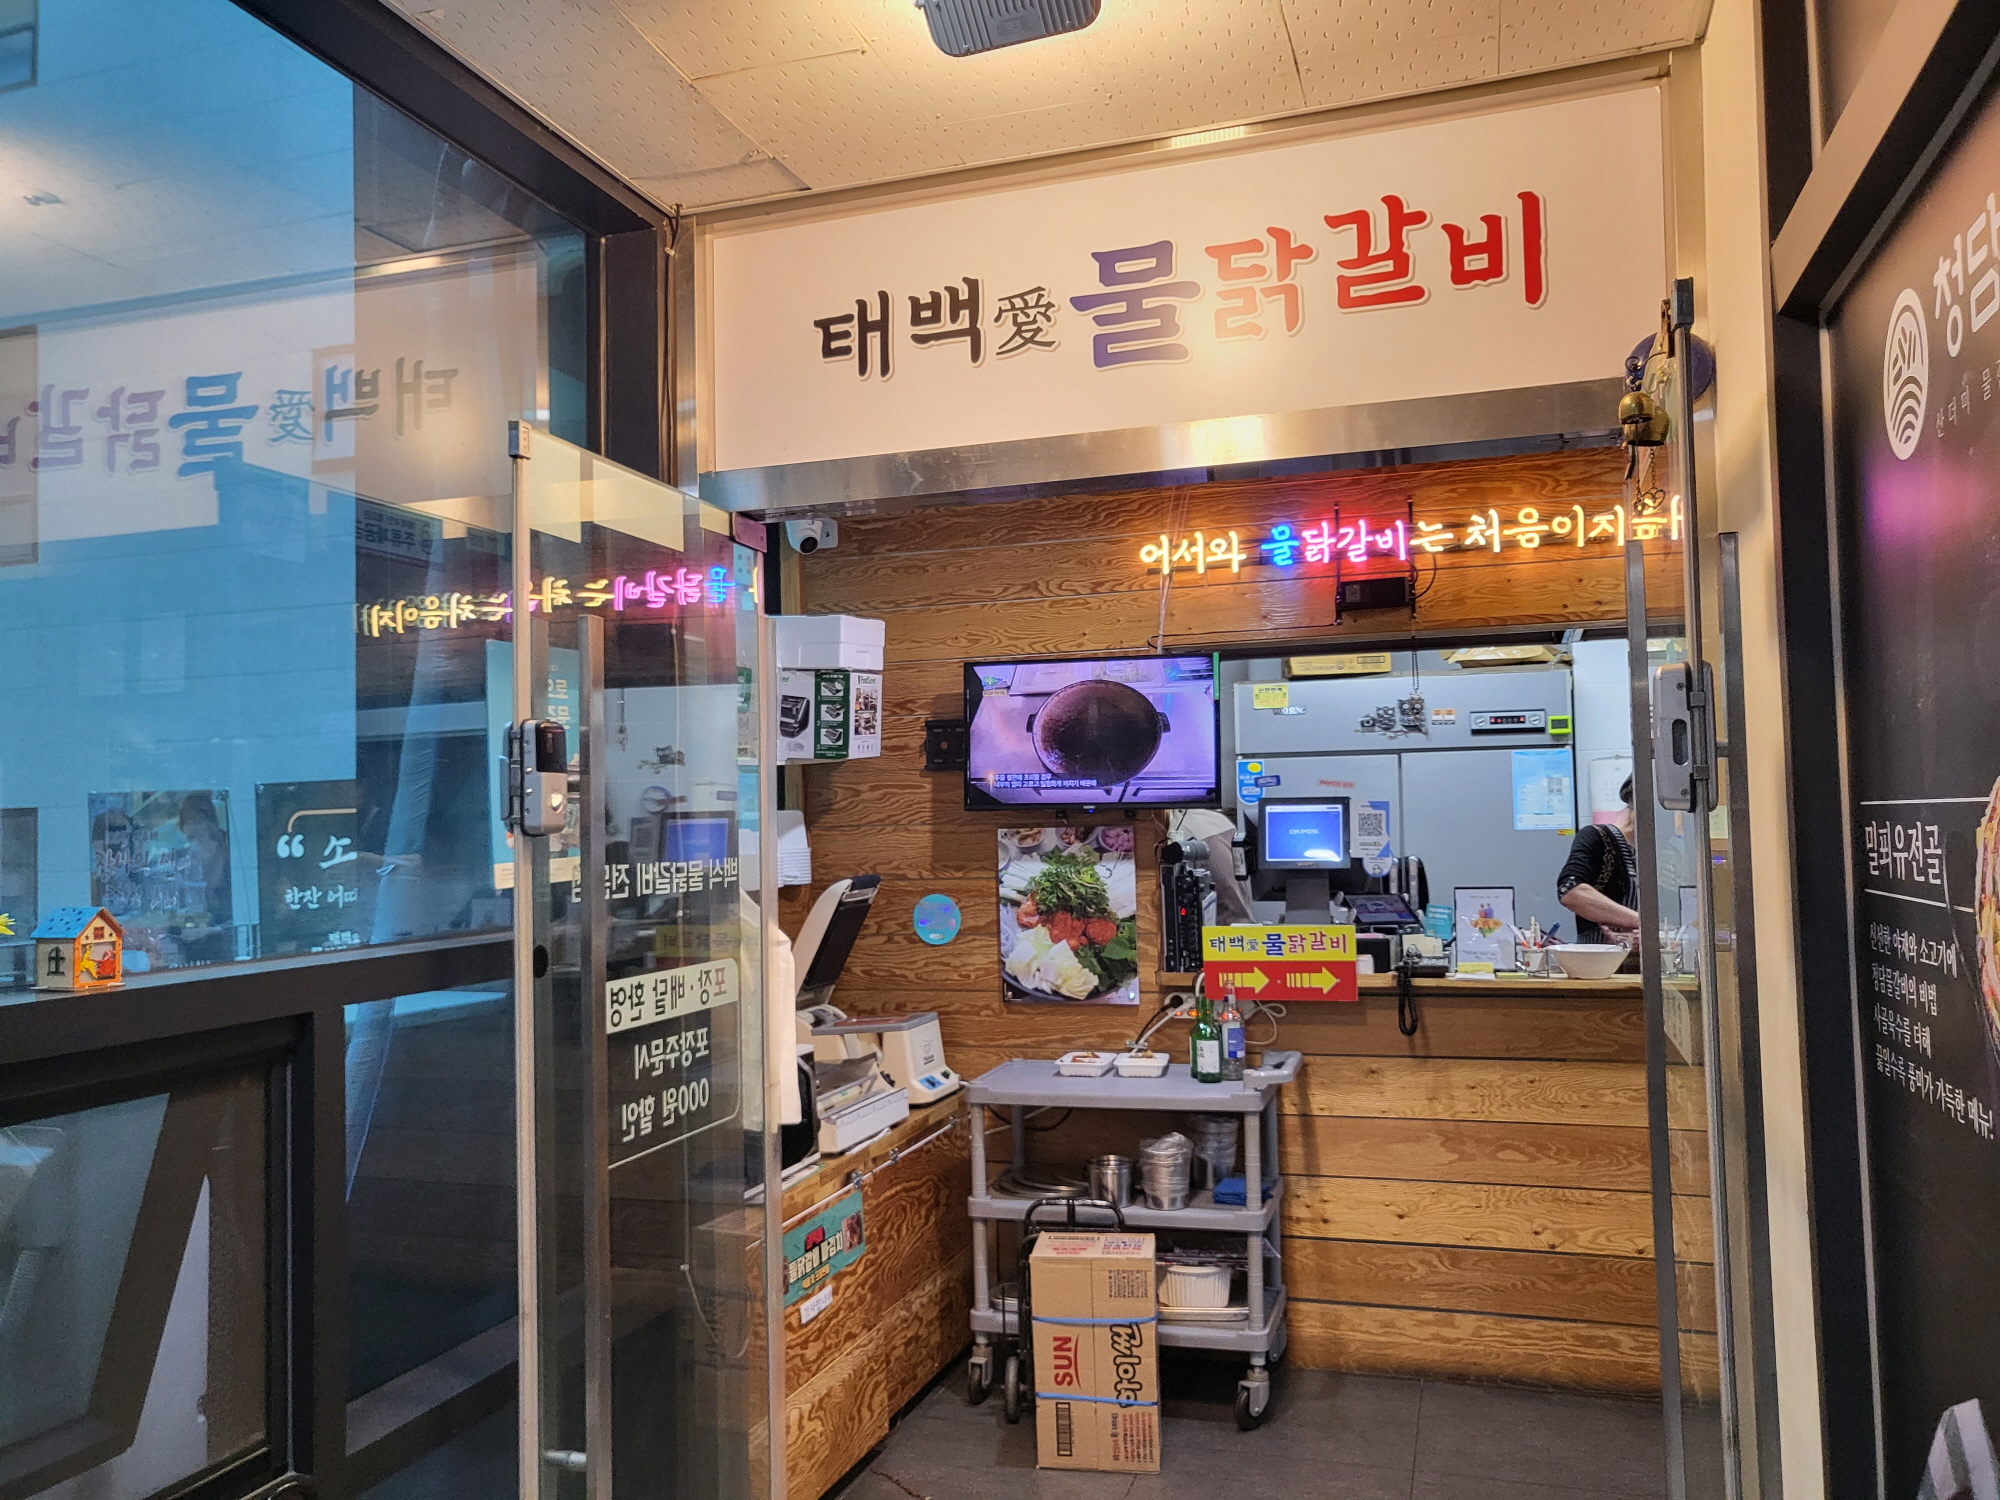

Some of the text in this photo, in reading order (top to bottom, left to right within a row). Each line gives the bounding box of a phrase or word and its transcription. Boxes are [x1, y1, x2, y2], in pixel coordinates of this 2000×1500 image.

[1140, 530, 1247, 576] 어서와
[1261, 518, 1454, 566] 물닭갈비는
[1865, 820, 1942, 885] 밀푀유전골
[1869, 921, 1891, 956] 신선한
[1919, 938, 1958, 979] 소고기에
[1918, 980, 1938, 1016] 비법
[1873, 1002, 1932, 1060] 사골육수를 더해
[1875, 1043, 1994, 1141] 끓일수록 풍미가 가득한 메뉴!
[1052, 1336, 1074, 1387] SUN
